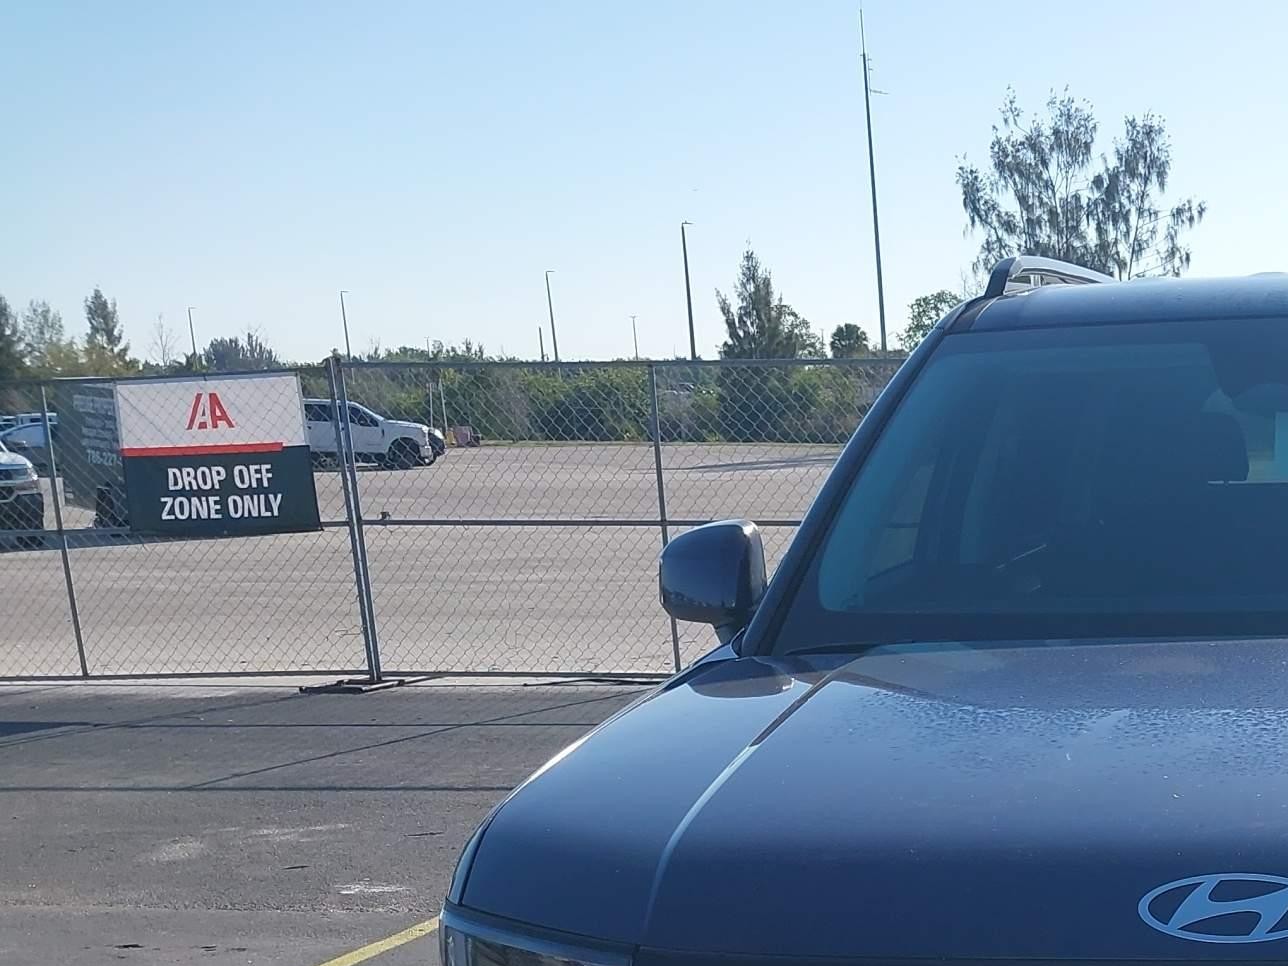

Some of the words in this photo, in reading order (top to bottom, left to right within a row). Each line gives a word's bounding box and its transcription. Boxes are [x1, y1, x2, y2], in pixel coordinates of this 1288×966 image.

[168, 466, 226, 490] DROP
[234, 464, 273, 489] OFF
[161, 497, 222, 520] ZONE
[228, 493, 283, 518] ONLY
